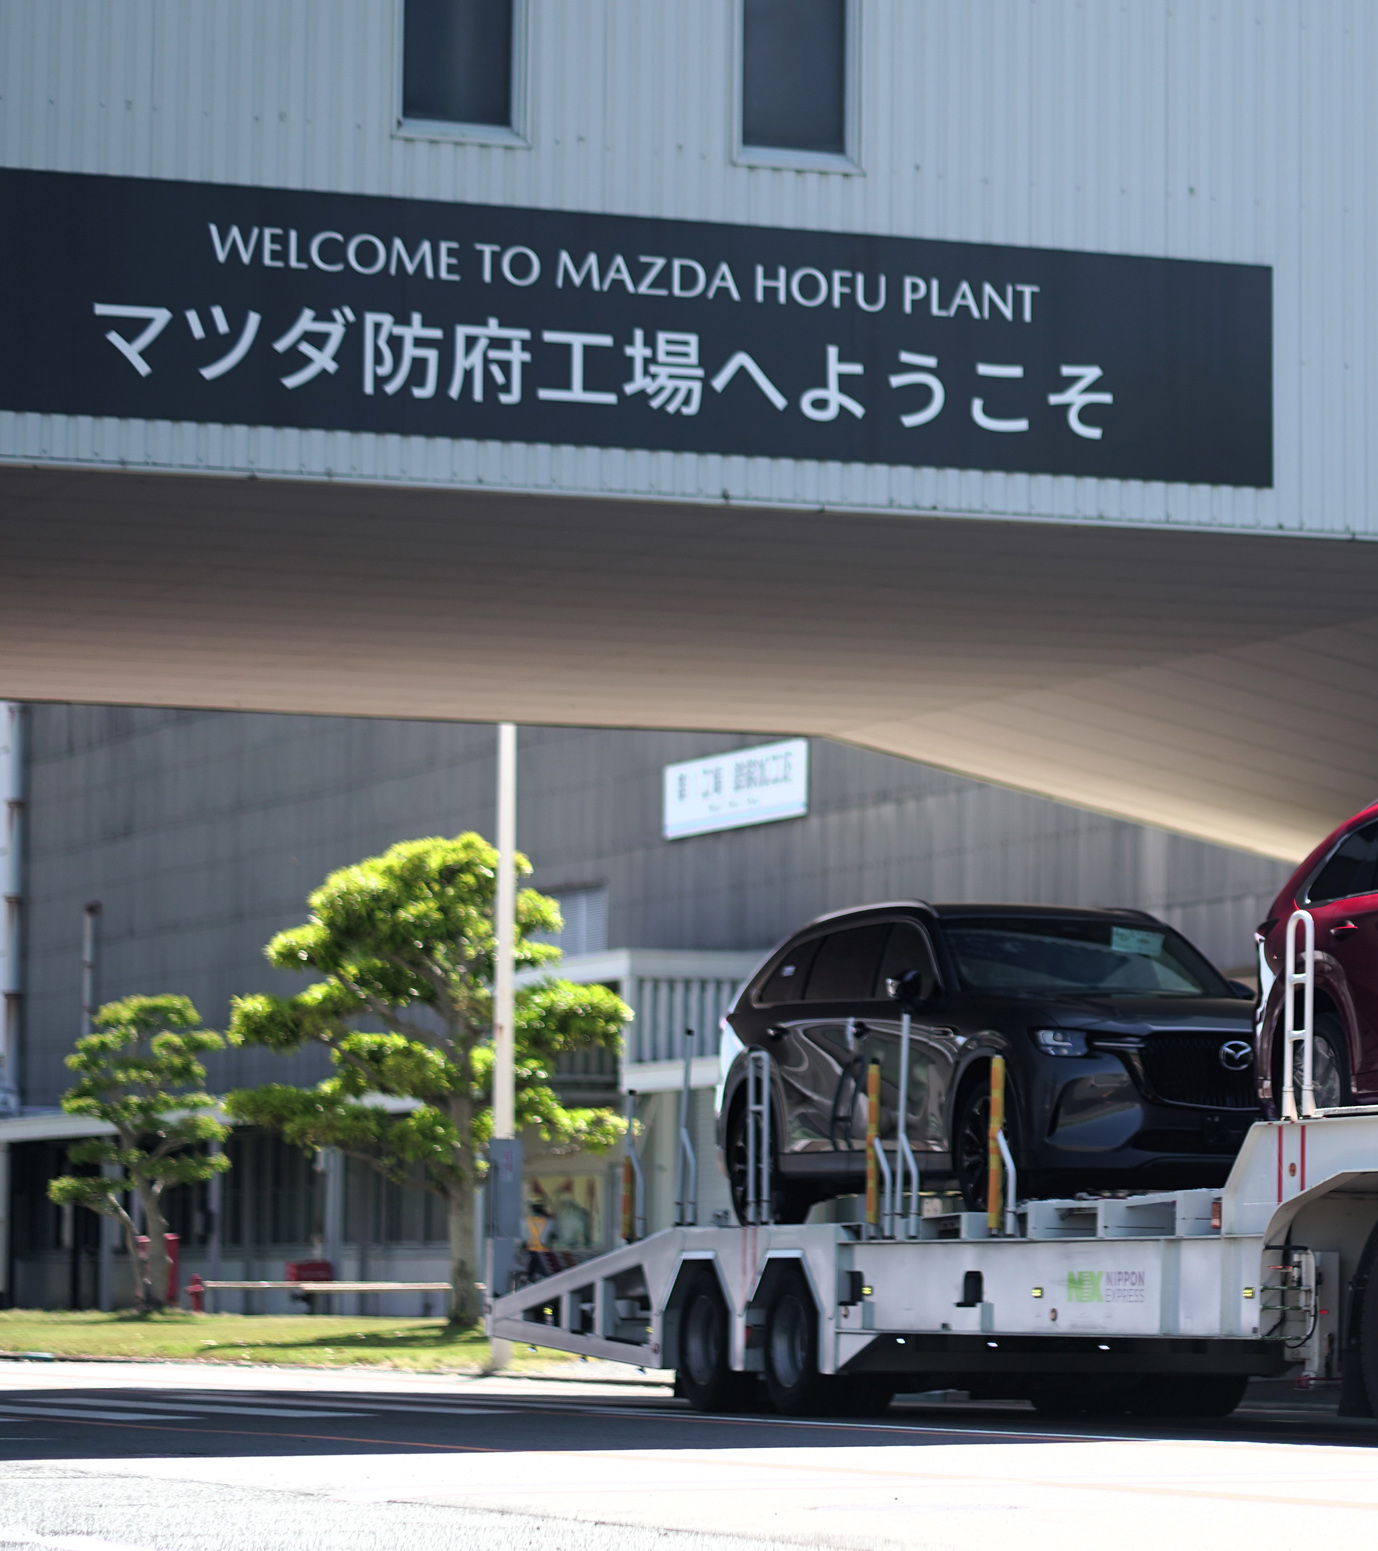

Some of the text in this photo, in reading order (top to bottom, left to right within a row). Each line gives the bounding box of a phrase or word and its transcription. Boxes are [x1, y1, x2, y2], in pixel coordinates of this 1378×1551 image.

[208, 222, 1040, 324] WELCOME TO MAZDA HOFU PLANT
[93, 301, 1114, 440] マツダ防府工場へようこそ
[1067, 1271, 1104, 1303] NX
[1106, 1271, 1145, 1287] NIPPON
[1105, 1288, 1145, 1303] EXPRESS
